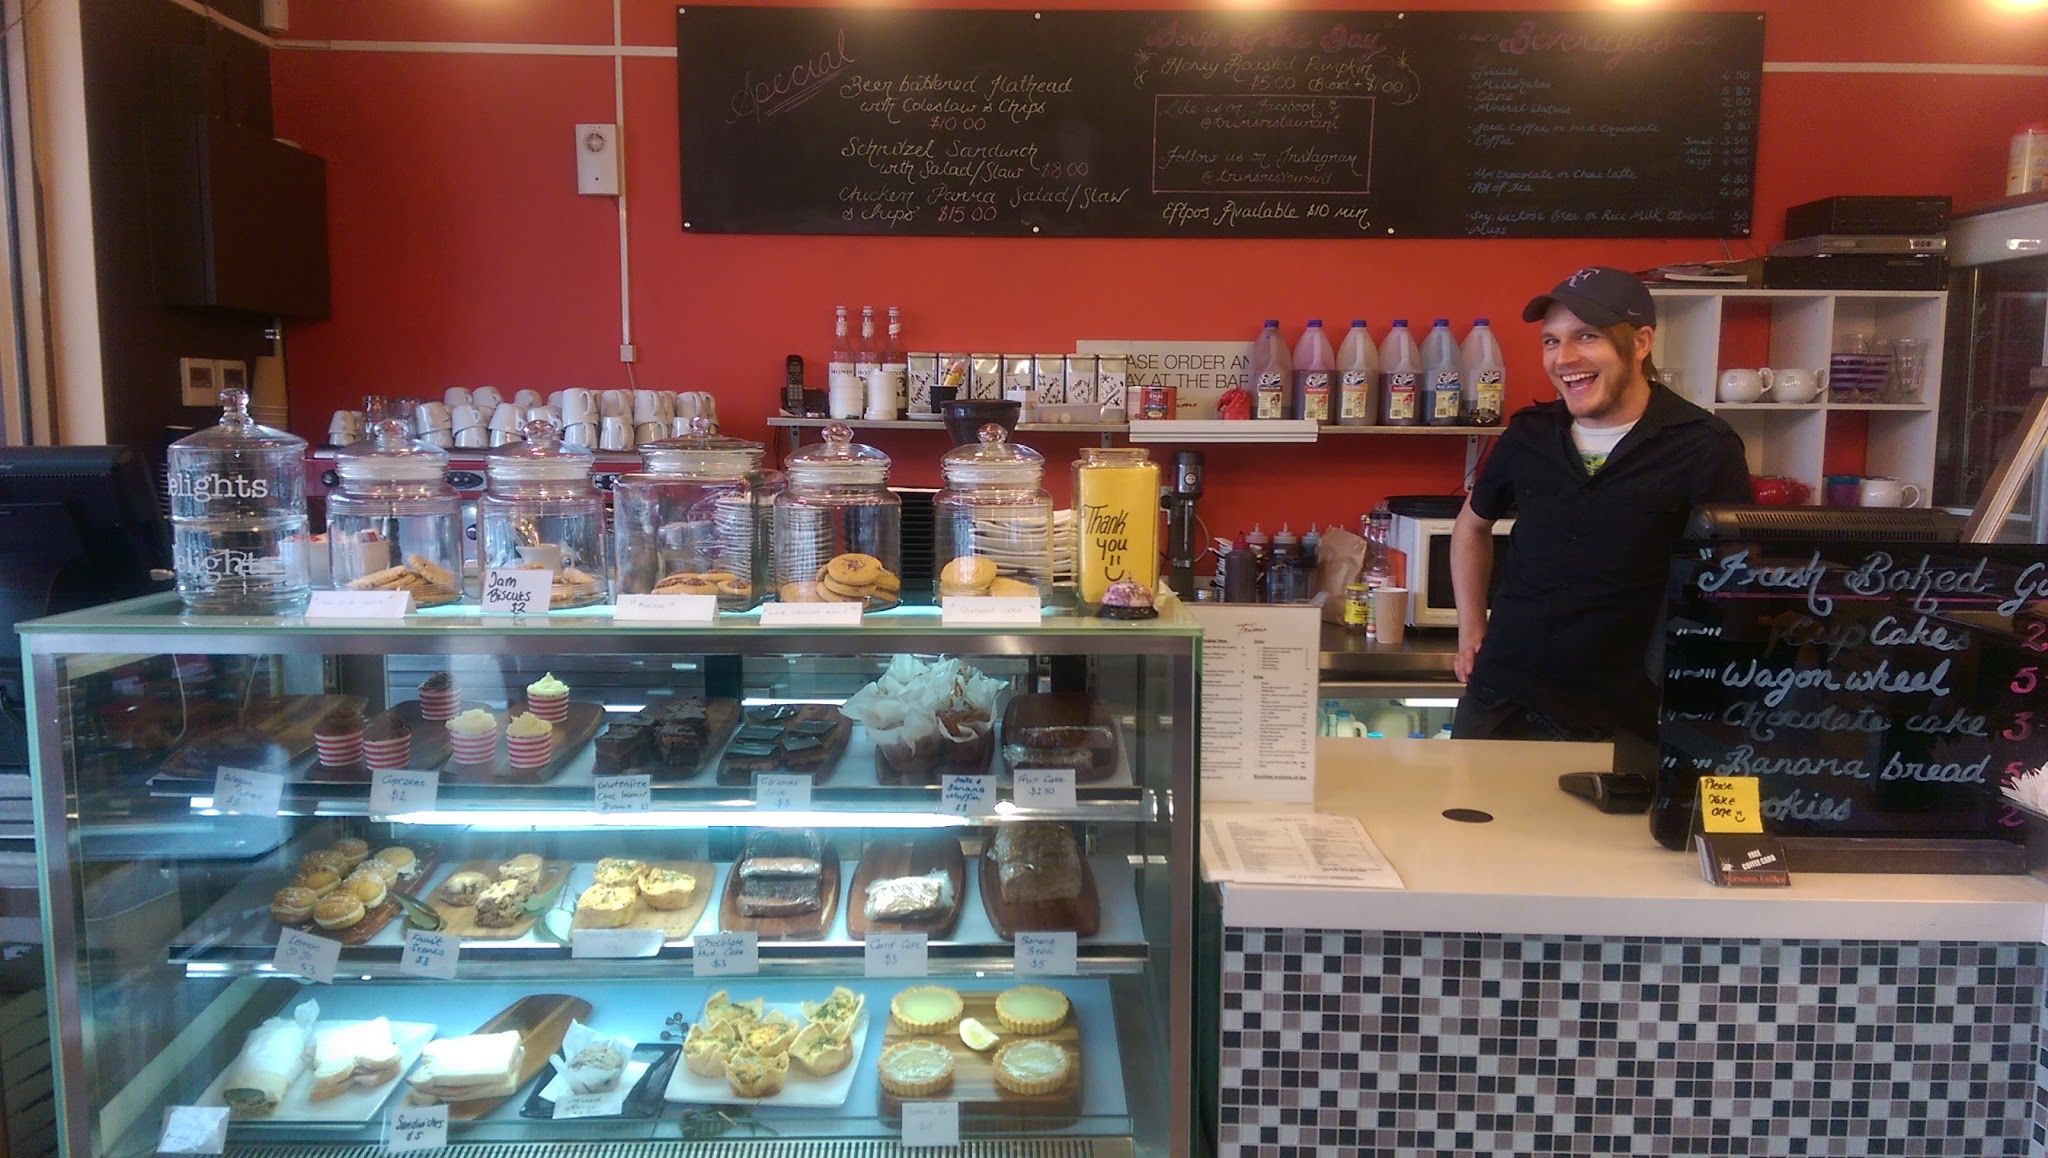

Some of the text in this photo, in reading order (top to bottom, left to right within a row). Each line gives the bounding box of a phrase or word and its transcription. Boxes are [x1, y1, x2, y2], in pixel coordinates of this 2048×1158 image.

[726, 28, 858, 127] Special
[1160, 55, 1220, 81] Honey
[860, 98, 901, 124] with
[998, 97, 1048, 124] Chips
[1159, 98, 1198, 120] Like
[1203, 104, 1223, 115] us
[1225, 103, 1242, 119] on
[1474, 134, 1516, 148] Coffee
[840, 136, 1042, 172] Schnitzel Sandwich
[1158, 145, 1218, 170] Follow
[1226, 152, 1245, 162] us
[880, 161, 917, 185] with
[926, 182, 998, 206] Parma
[1162, 200, 1210, 226] Eftpos
[1212, 200, 1300, 228] Available
[1306, 204, 1330, 219] $10
[1127, 354, 1251, 372] ASE ORDER AN
[1125, 373, 1146, 389] AY
[1151, 373, 1172, 389] AT
[1174, 374, 1211, 390] THE
[168, 472, 270, 503] elights
[1083, 504, 1129, 534] Thank
[1097, 538, 1128, 561] you
[487, 571, 517, 588] Jam
[1846, 552, 1987, 615] Baked
[510, 601, 526, 615] $2
[1721, 658, 1841, 708] Wagon
[1845, 658, 1951, 697] wheel
[1721, 701, 1891, 742] Chocolate
[1905, 707, 1989, 738] cake
[1715, 744, 1992, 784] Banana bread
[1704, 778, 1734, 791] Please
[1761, 788, 1852, 822] okies
[1741, 854, 1777, 870] COFFEE CARD
[1747, 849, 1763, 860] FREE
